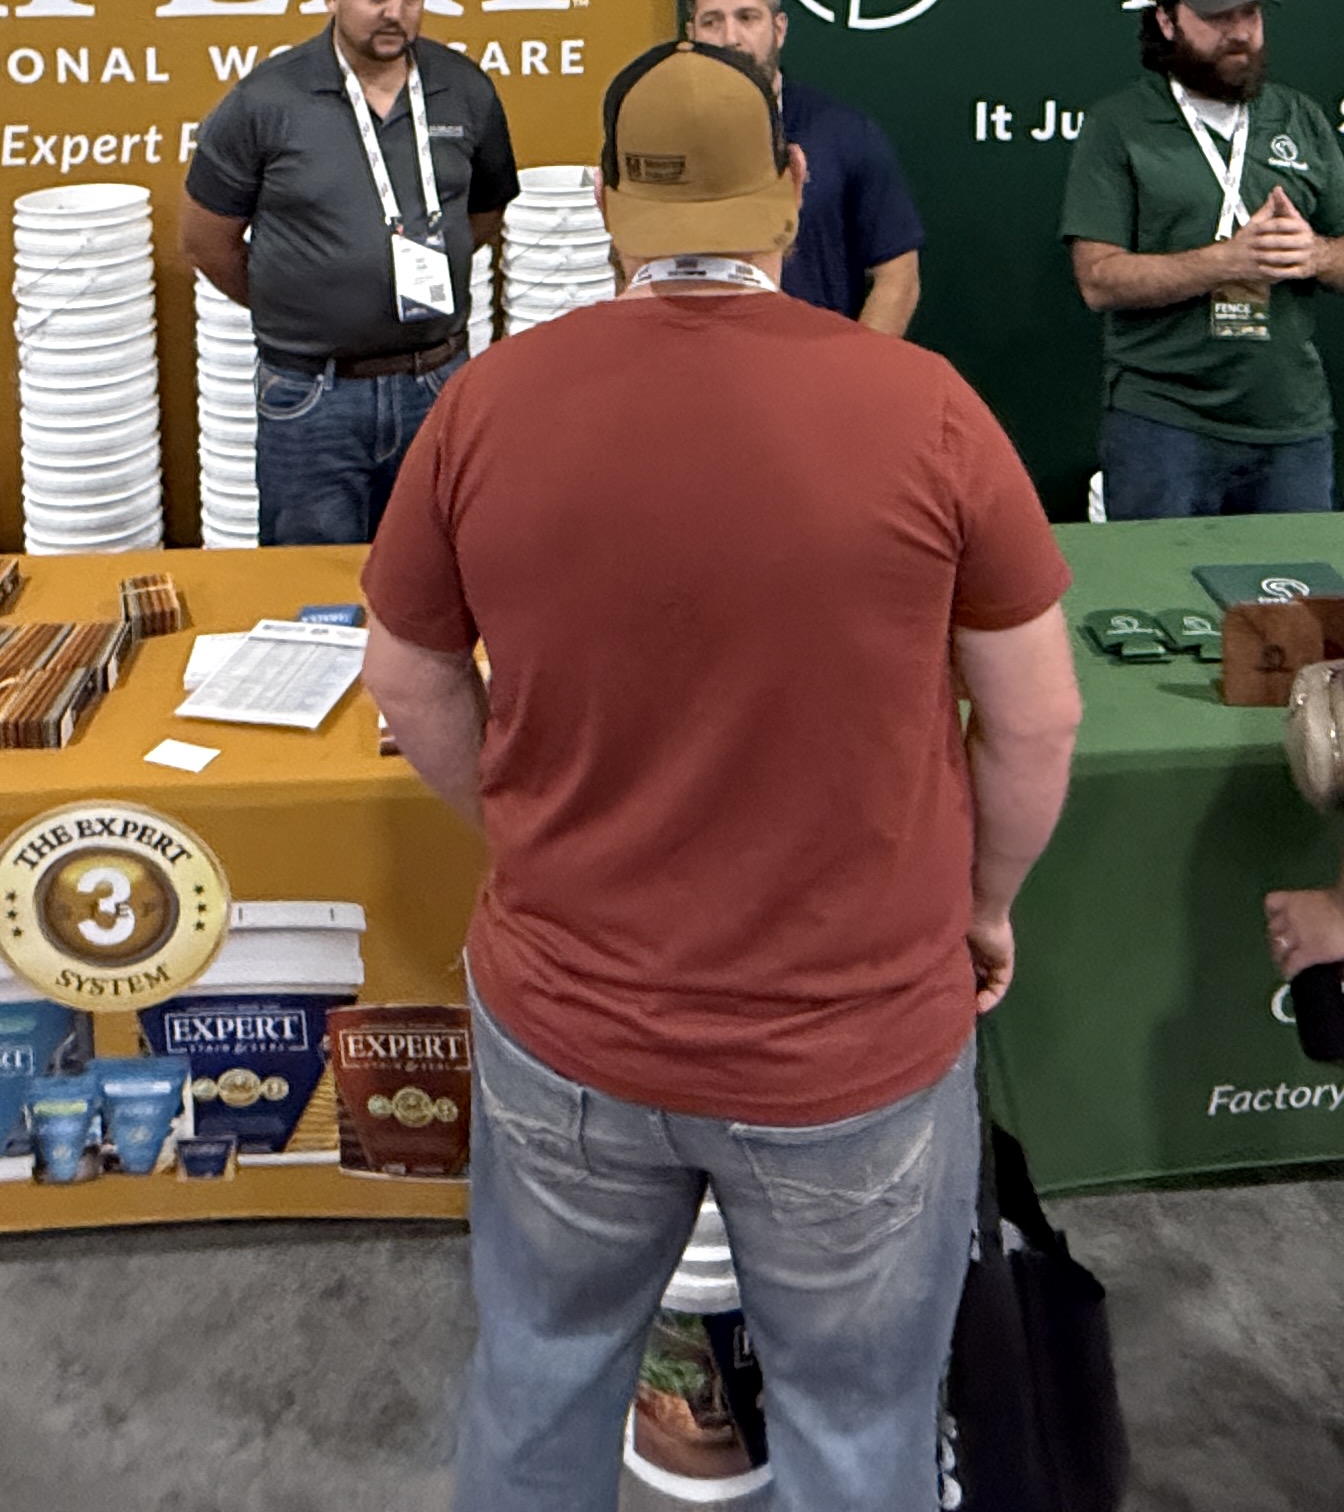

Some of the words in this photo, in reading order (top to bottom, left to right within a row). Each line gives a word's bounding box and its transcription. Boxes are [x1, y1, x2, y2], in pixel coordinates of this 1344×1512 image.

[975, 101, 1012, 141] It
[1031, 100, 1086, 141] Ju
[1, 124, 163, 174] Expert
[13, 824, 73, 872] THE
[74, 816, 193, 866] EXPERT
[76, 866, 136, 946] 3
[55, 962, 171, 997] SYSTEM
[172, 1015, 299, 1041] EXPERT
[347, 1034, 464, 1059] EXPERT
